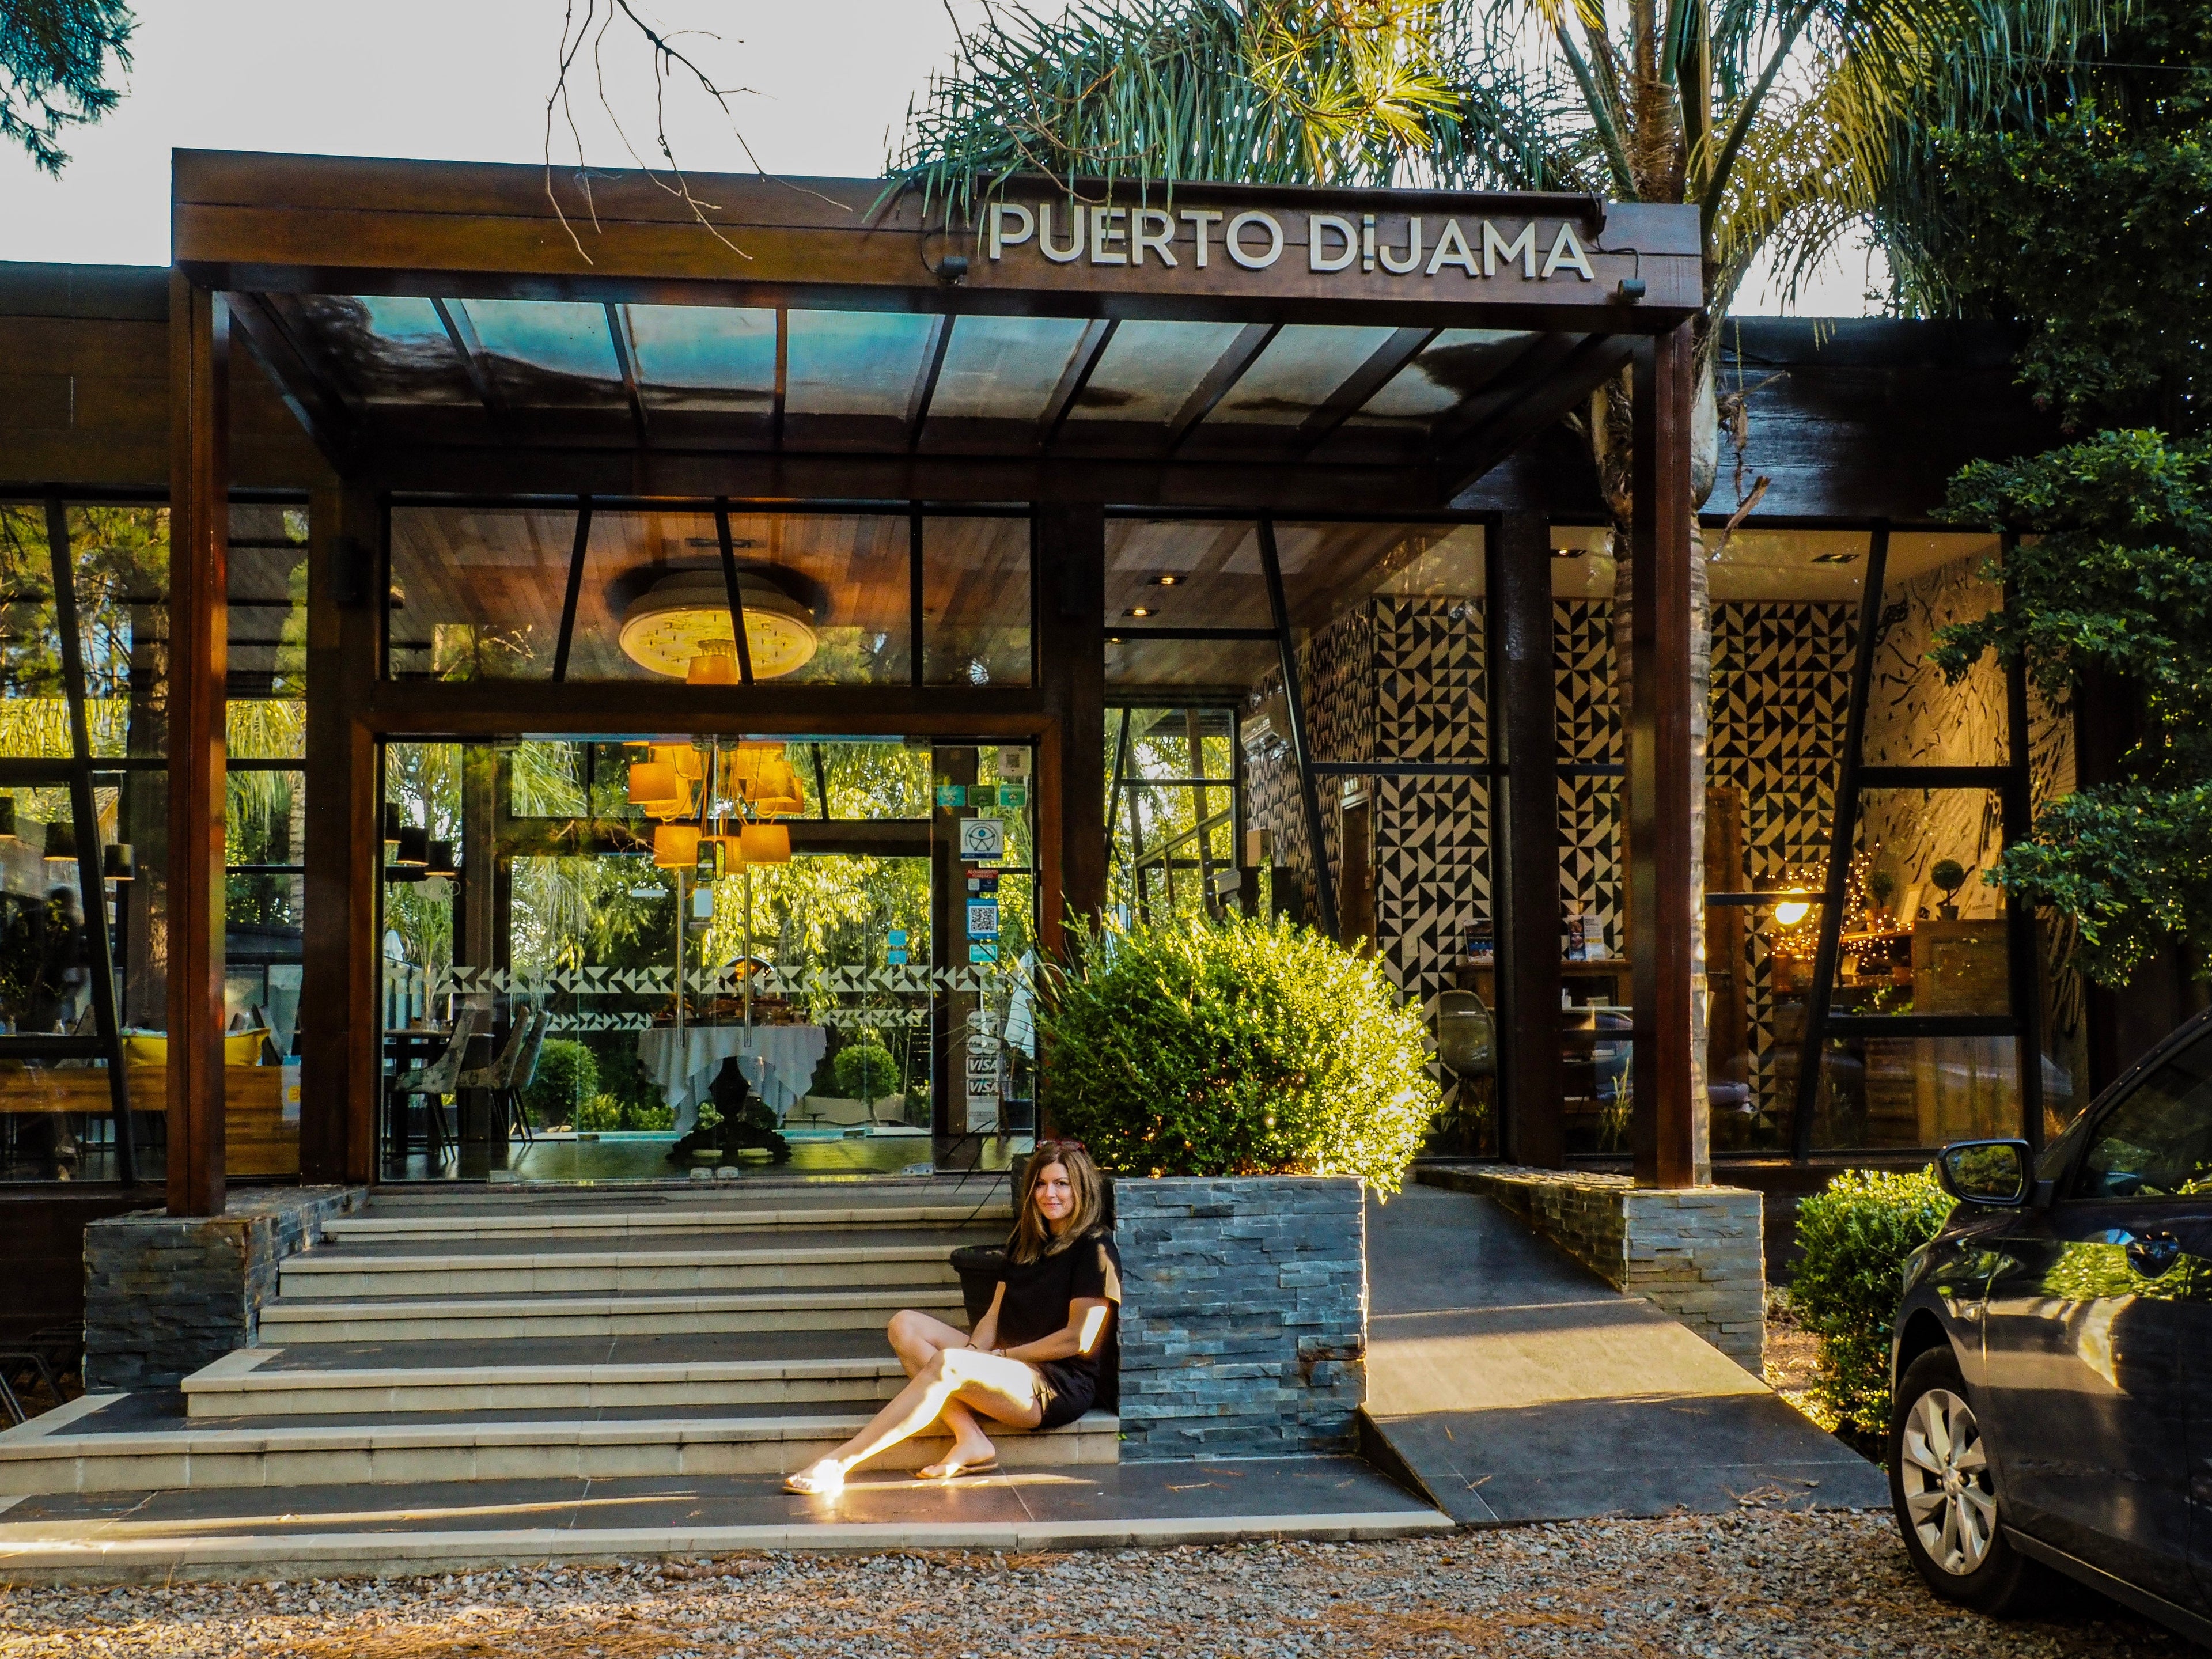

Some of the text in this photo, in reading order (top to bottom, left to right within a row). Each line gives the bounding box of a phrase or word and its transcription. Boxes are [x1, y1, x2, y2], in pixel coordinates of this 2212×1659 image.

[989, 202, 1284, 269] PUERTO
[969, 1059, 998, 1071] VISA
[969, 1081, 998, 1093] VISA
